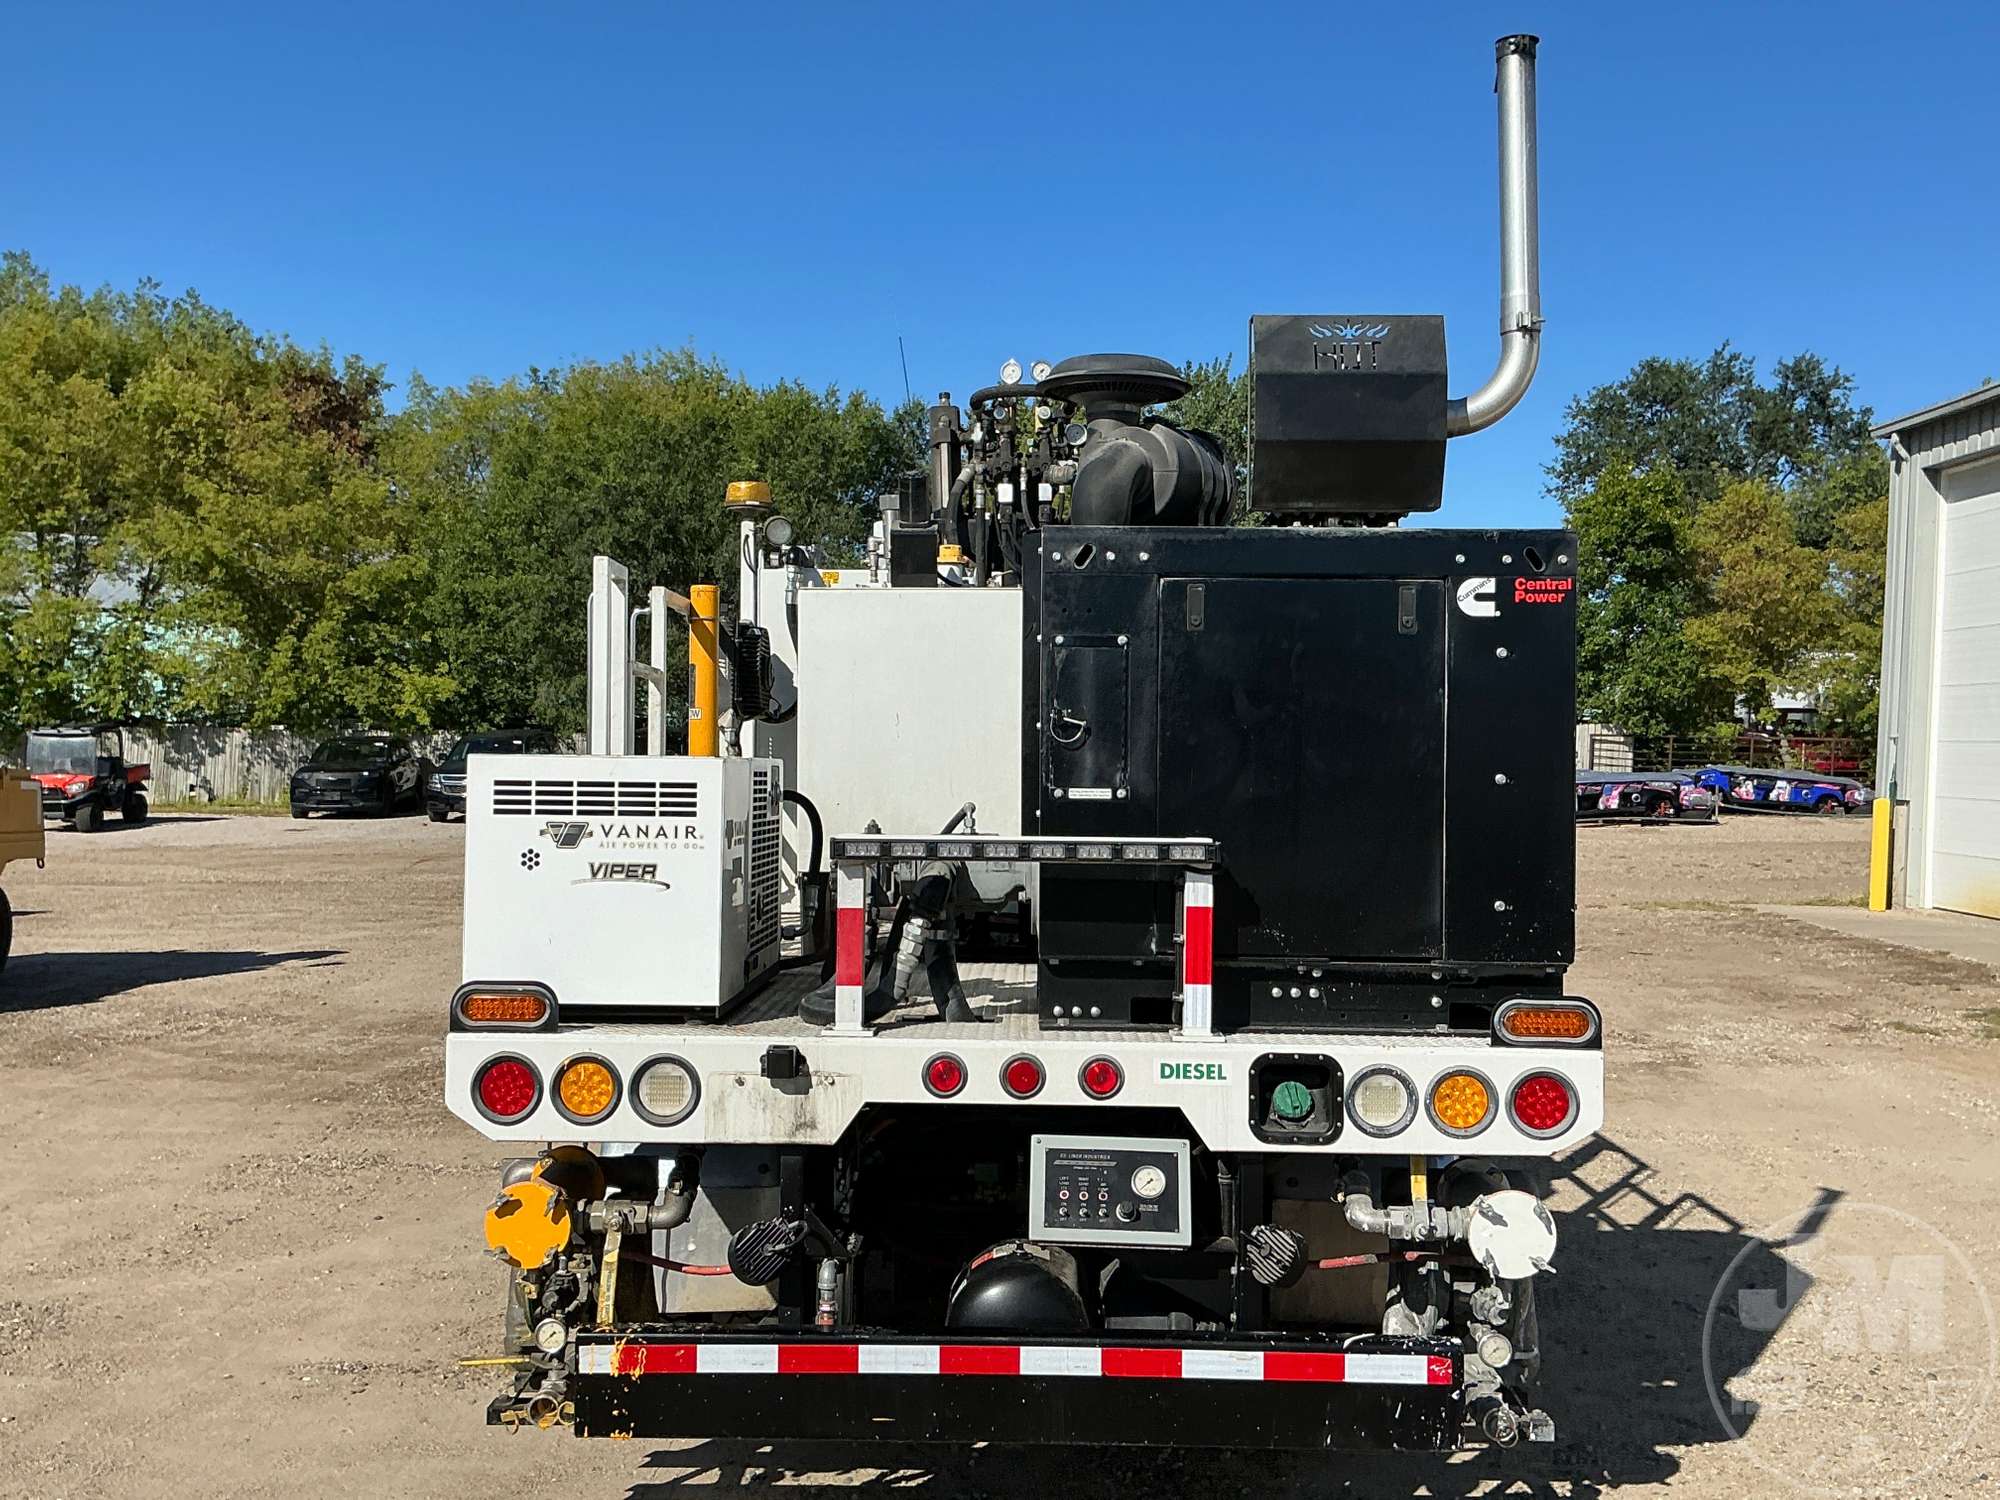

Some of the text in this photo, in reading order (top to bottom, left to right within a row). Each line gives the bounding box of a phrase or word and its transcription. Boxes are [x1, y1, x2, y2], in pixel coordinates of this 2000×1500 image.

[1456, 577, 1493, 602] Cummins
[1514, 577, 1573, 590] Central
[1514, 590, 1566, 603] Power
[600, 823, 698, 840] VANAIR
[588, 861, 658, 880] VIPER
[1160, 1062, 1227, 1081] DIESEL
